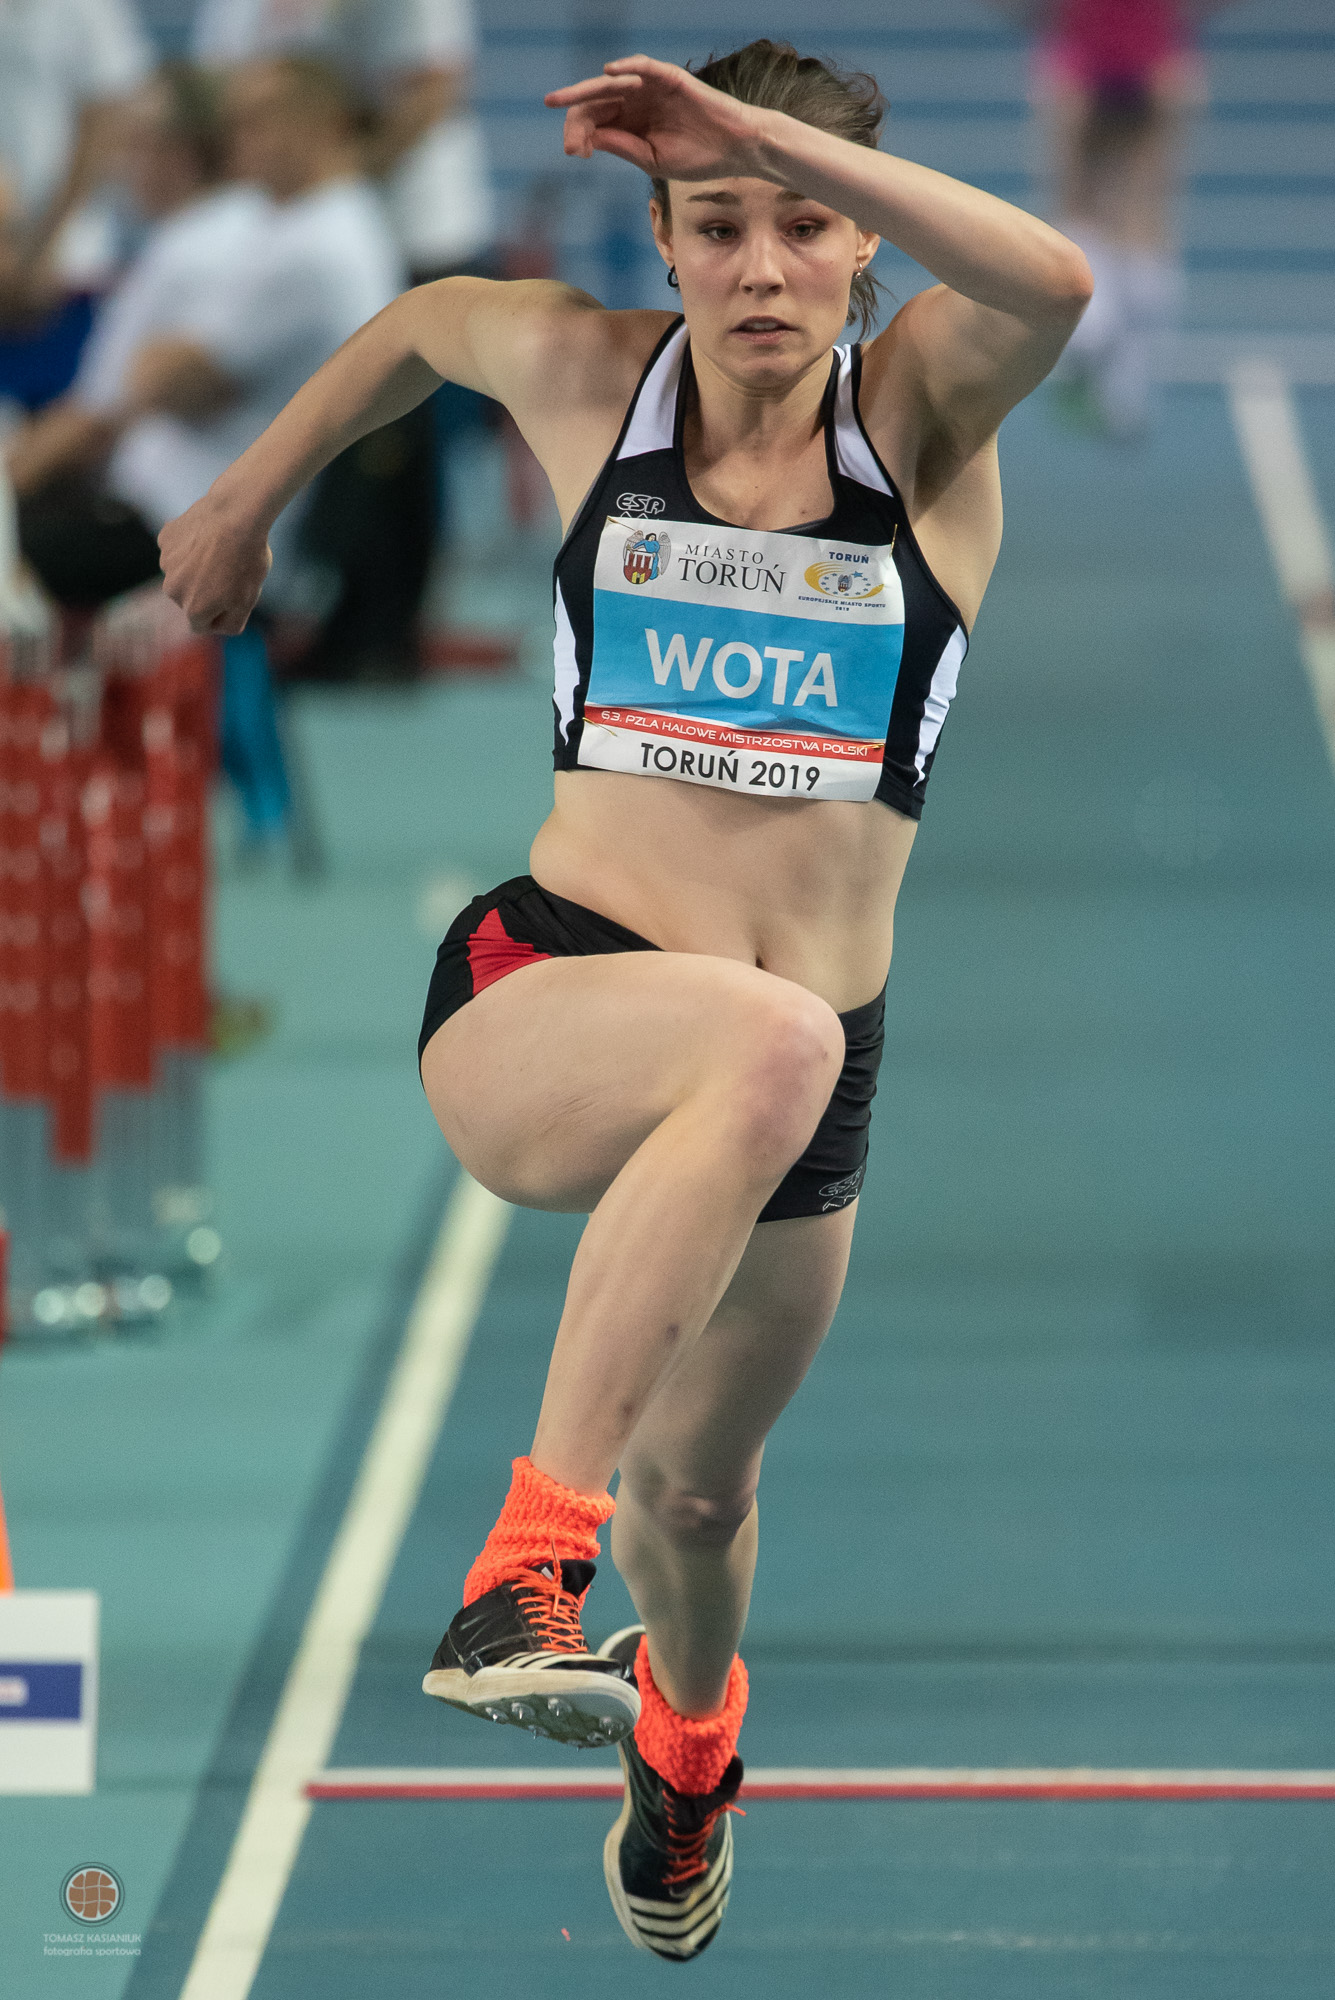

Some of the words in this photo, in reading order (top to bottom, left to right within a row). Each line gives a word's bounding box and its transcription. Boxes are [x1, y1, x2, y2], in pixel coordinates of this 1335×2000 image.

[685, 544, 764, 565] MIASTO
[828, 551, 869, 564] TORUŃ
[678, 557, 787, 594] TORUŃ
[798, 596, 839, 605] EUROPEJSKIE
[644, 628, 838, 707] WOTA
[601, 710, 622, 723] 63.
[625, 714, 660, 729] PZLA
[662, 721, 716, 739] HALOWE
[719, 732, 820, 752] MISTRZOSTWA
[823, 743, 868, 757] POLSKI
[641, 742, 739, 783] TORUŃ
[749, 760, 820, 792] 2019
